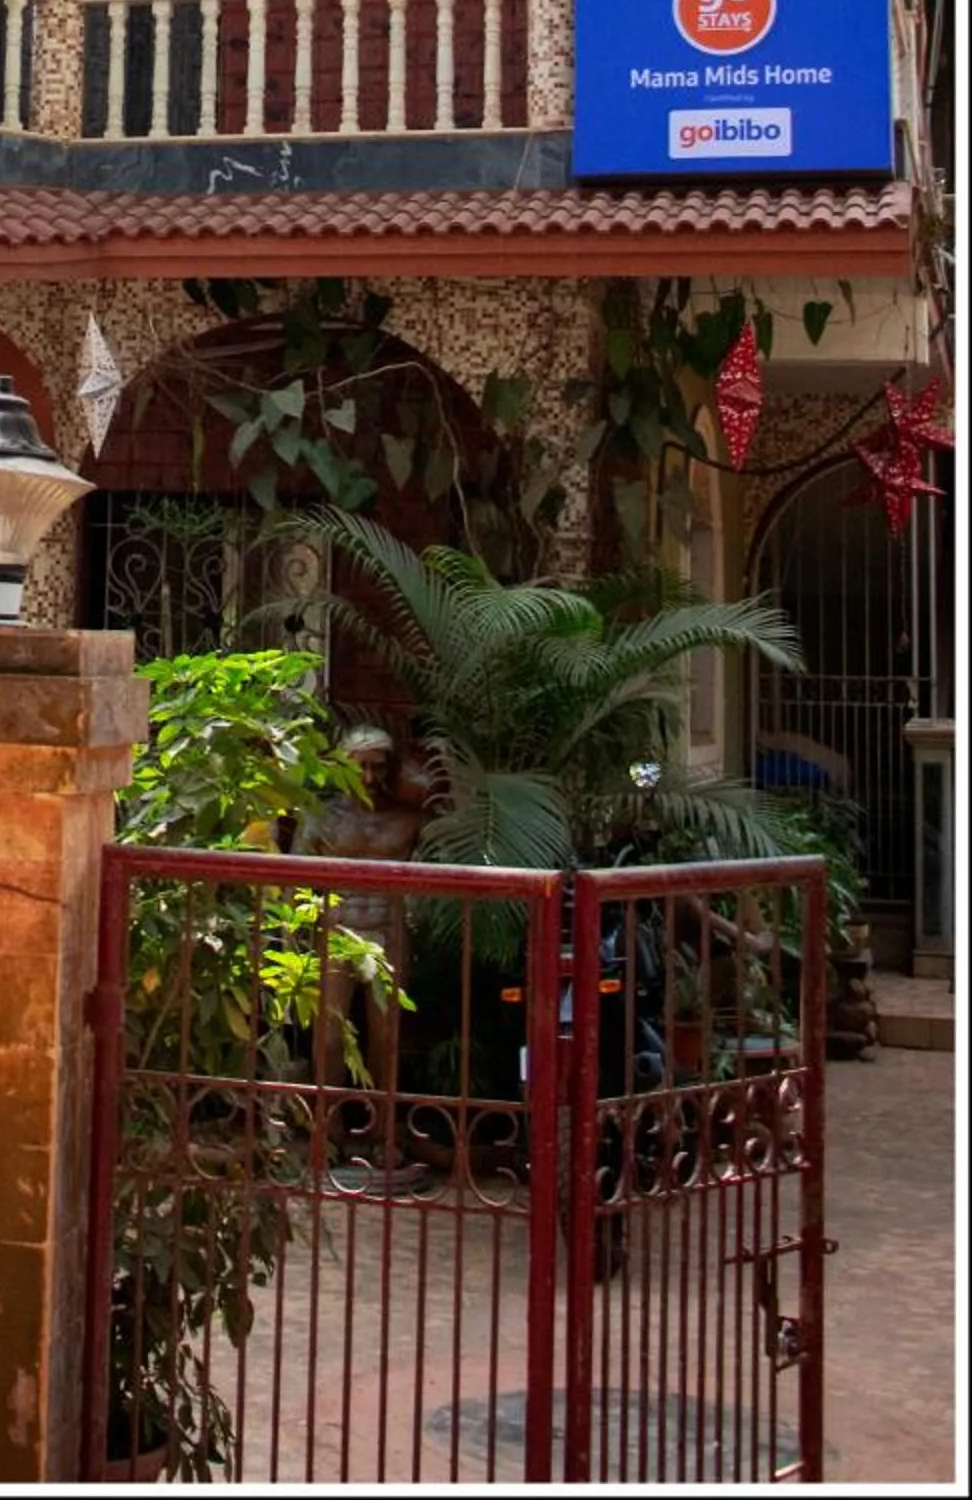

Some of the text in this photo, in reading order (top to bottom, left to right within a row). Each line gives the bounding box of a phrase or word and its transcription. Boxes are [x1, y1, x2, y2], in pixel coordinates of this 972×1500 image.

[697, 11, 752, 28] STAYS
[630, 65, 833, 88] Mama Mids Home
[680, 119, 781, 149] goibibo
